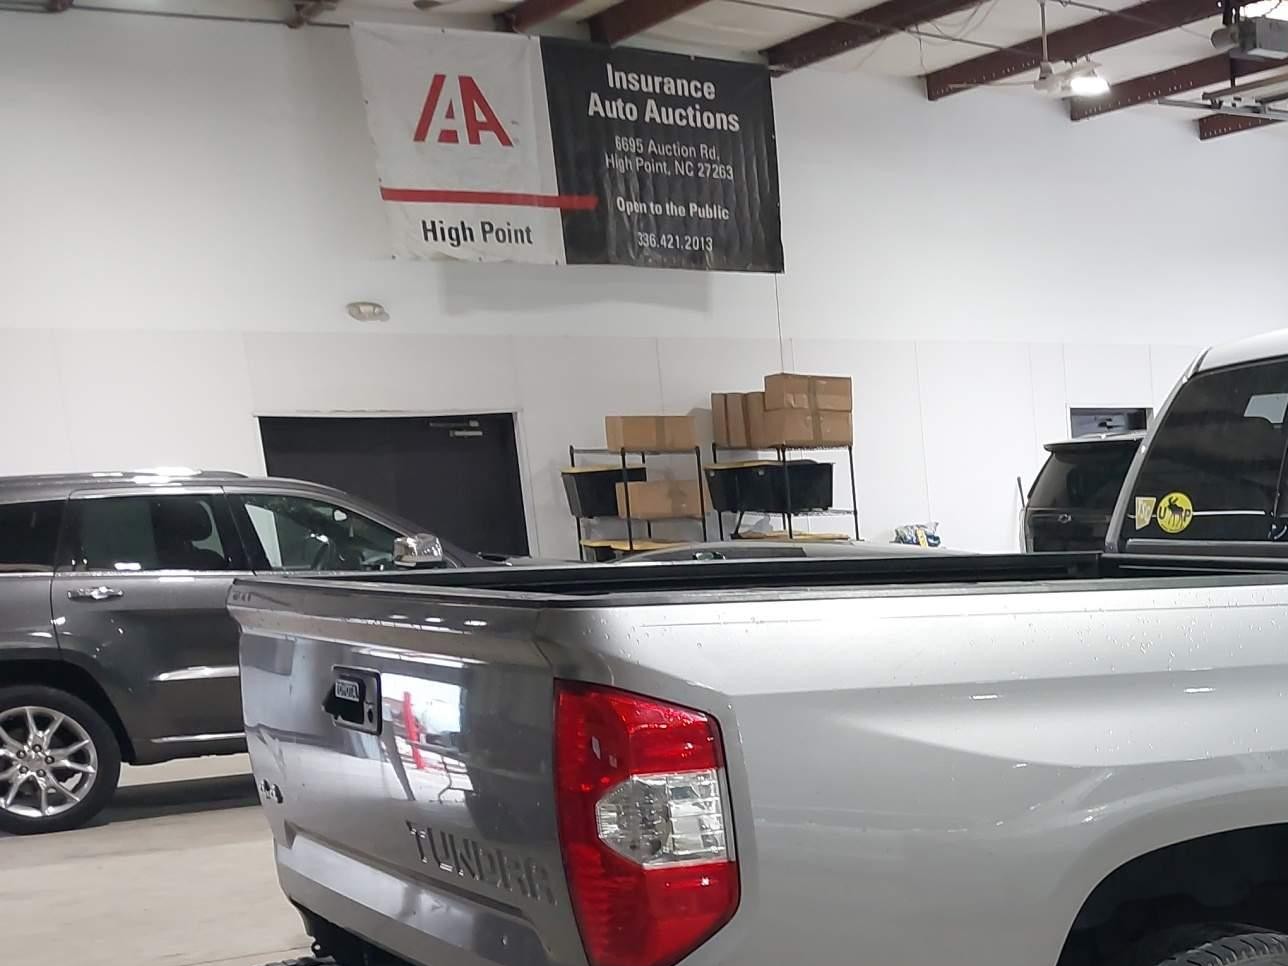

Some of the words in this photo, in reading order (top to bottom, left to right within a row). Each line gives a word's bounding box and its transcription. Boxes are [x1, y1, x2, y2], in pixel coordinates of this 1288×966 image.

[606, 63, 716, 100] Insurance
[588, 92, 638, 121] Auto
[644, 98, 740, 132] Auctions
[615, 135, 643, 153] 6695
[647, 139, 697, 157] Auction
[605, 152, 633, 174] High
[674, 160, 694, 177] NC
[697, 163, 733, 180] 27263
[649, 201, 663, 215] to
[665, 201, 686, 217] the
[689, 202, 730, 220] Public
[421, 219, 474, 247] High
[480, 221, 533, 244] Point
[405, 819, 559, 907] TUNDRA
